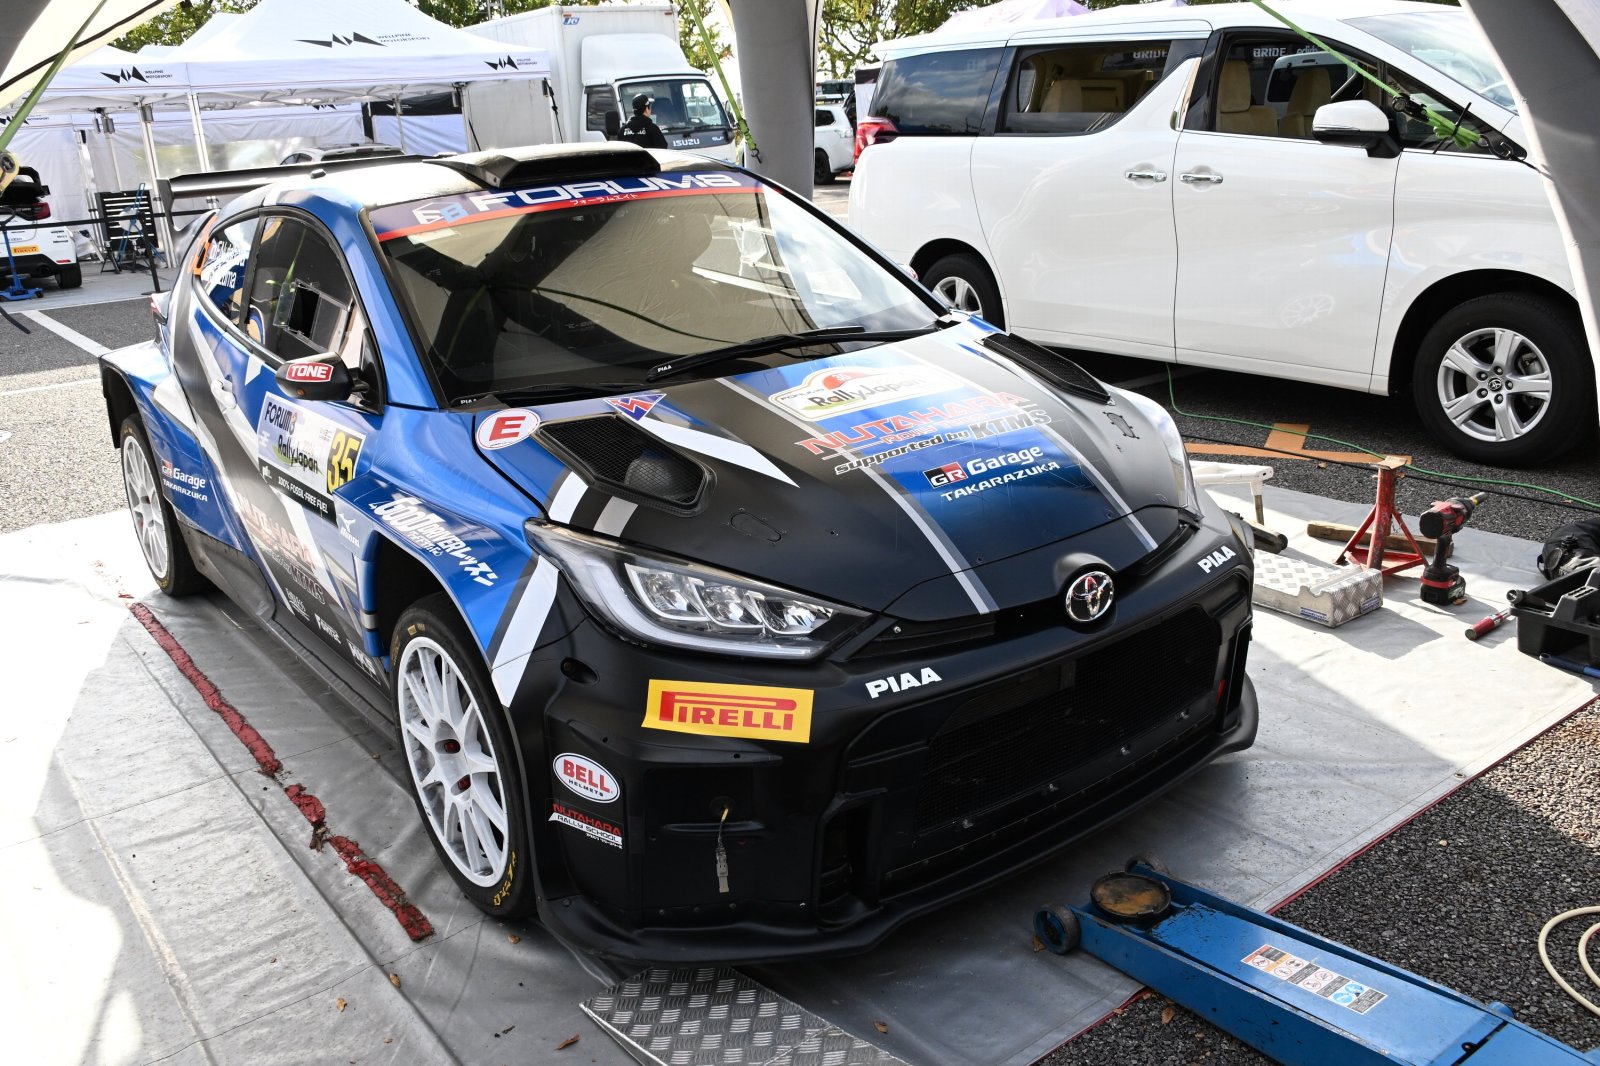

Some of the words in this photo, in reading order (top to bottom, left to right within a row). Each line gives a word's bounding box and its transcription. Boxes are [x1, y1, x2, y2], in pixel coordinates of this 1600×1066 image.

[1253, 47, 1287, 58] BRIDE
[672, 138, 700, 147] ISUZU
[468, 173, 742, 212] FORUM8
[290, 365, 329, 379] TONE
[657, 364, 673, 373] PIAA
[489, 415, 527, 442] E
[794, 391, 1031, 456] NUTAHARA
[835, 433, 943, 476] supported
[945, 429, 970, 443] by
[968, 408, 1052, 440] KTMS
[327, 431, 361, 493] 35
[929, 469, 966, 487] GR
[966, 446, 1044, 476] Garage
[163, 478, 208, 502] TAKARAZUKA
[173, 467, 206, 490] Garage
[940, 461, 1061, 502] TAKARAZUKA
[316, 499, 329, 514] FUEL
[1196, 545, 1237, 574] PIAA
[865, 673, 943, 699] PIAA
[658, 690, 798, 731] PIRELLI
[563, 758, 611, 794] BELL
[568, 778, 604, 797] HELMETS
[552, 803, 622, 837] NUTAHARA
[557, 814, 584, 830] RALLY
[585, 826, 620, 843] SCHOOL
